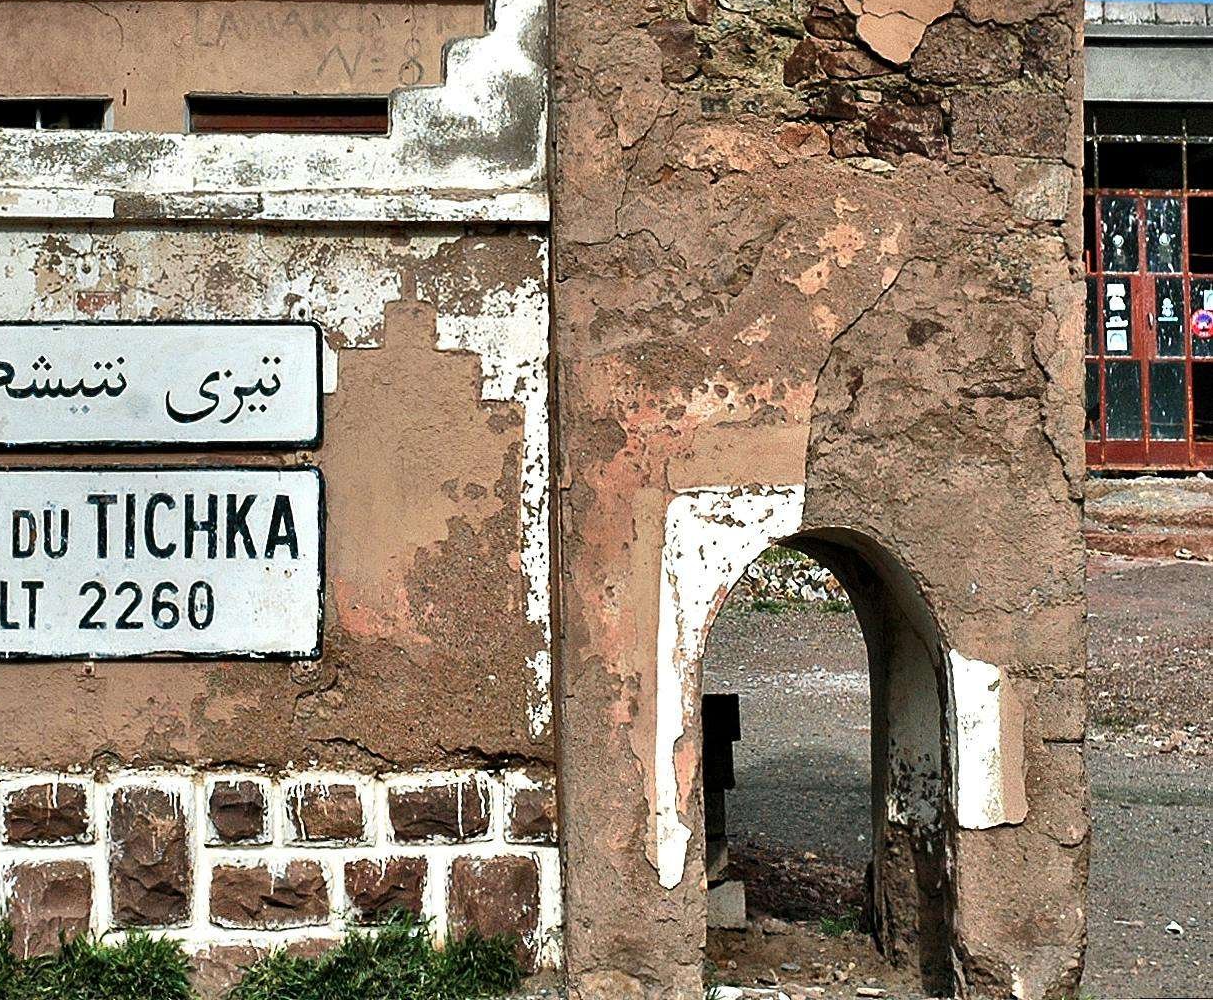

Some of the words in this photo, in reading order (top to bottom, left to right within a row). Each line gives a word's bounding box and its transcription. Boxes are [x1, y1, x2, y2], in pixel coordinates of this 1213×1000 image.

[12, 508, 68, 559] DU
[86, 492, 300, 560] TICHKA
[78, 579, 215, 630] 2260
